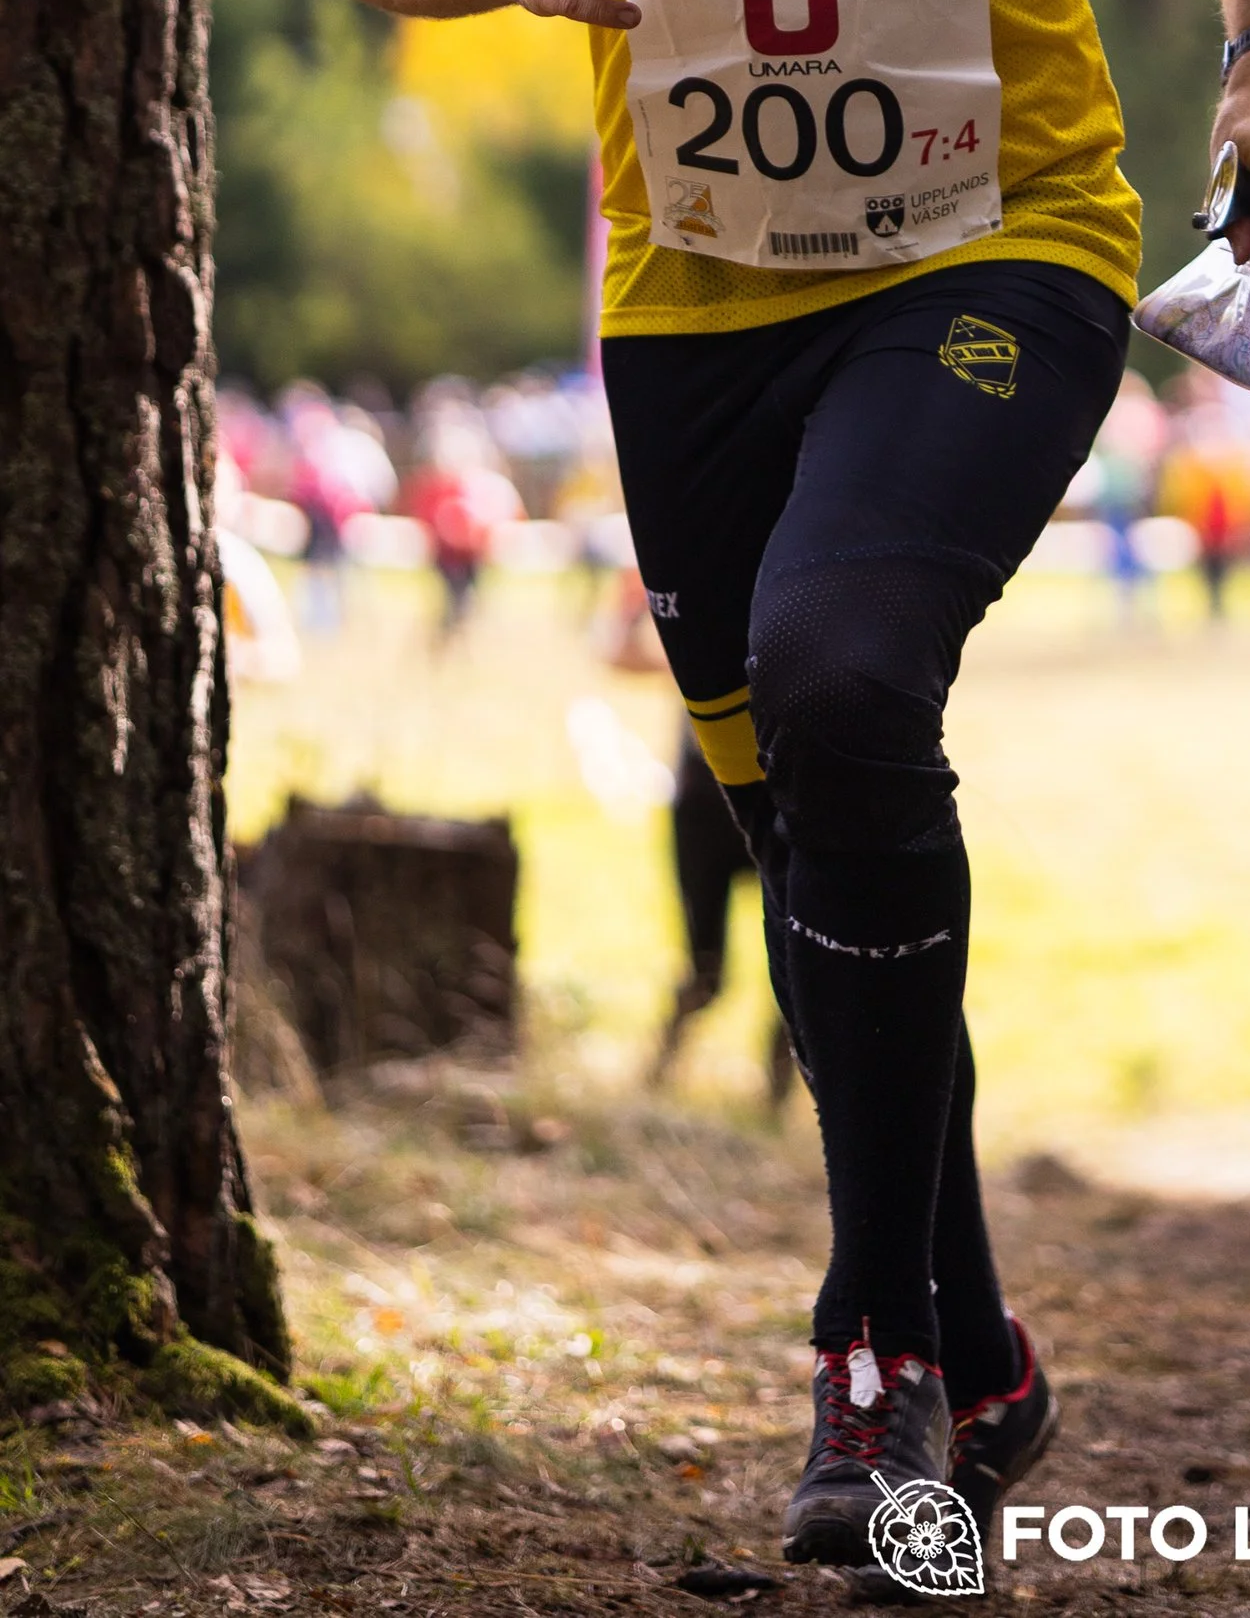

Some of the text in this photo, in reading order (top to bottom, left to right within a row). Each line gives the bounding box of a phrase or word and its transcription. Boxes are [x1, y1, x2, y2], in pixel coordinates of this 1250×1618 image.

[748, 58, 842, 78] UMARA
[668, 76, 905, 181] 200
[911, 119, 980, 166] 7:4
[910, 171, 990, 209] UPPLANDS
[910, 199, 961, 226] VÄSBY
